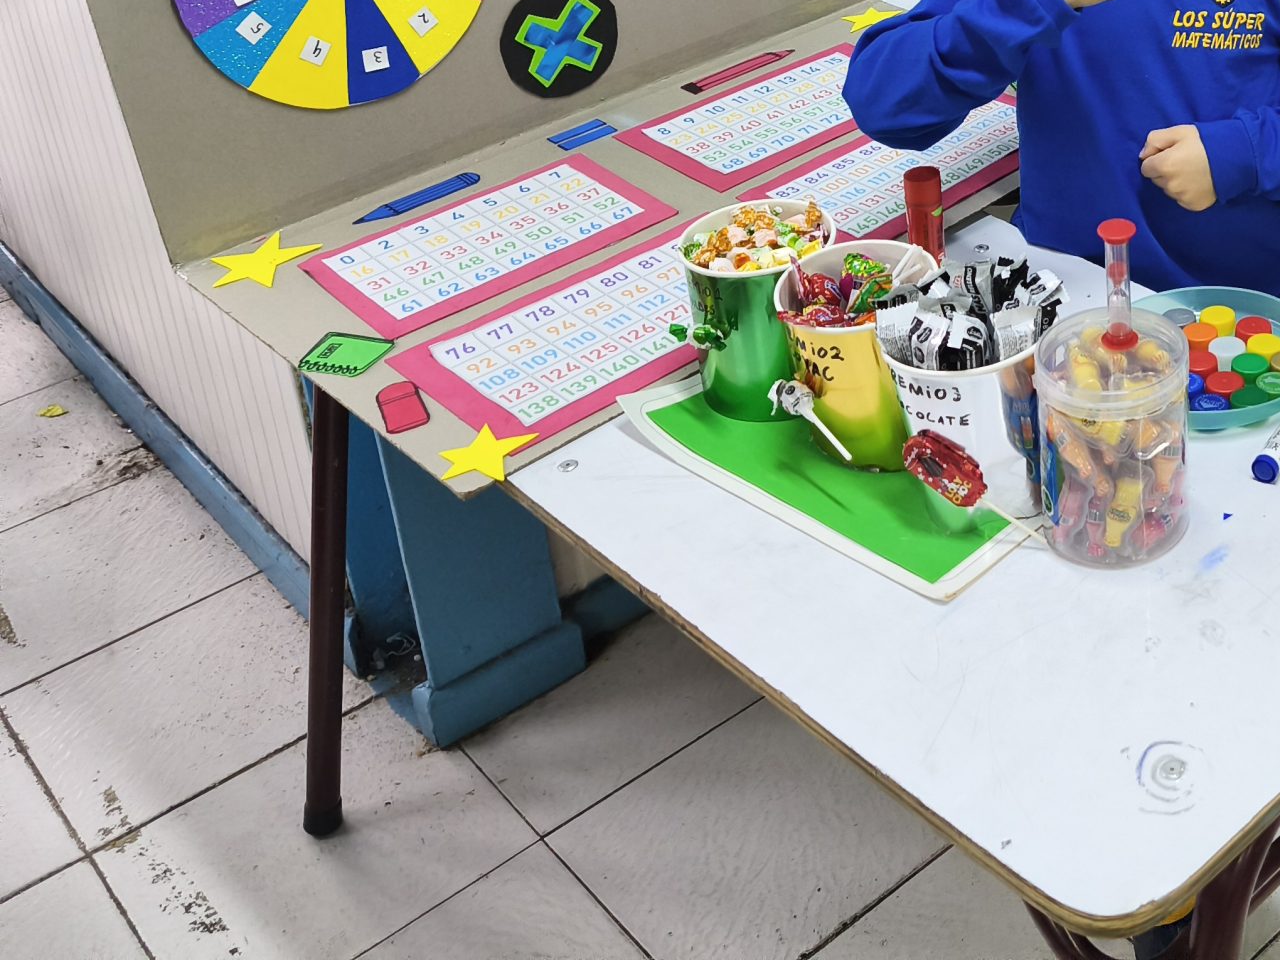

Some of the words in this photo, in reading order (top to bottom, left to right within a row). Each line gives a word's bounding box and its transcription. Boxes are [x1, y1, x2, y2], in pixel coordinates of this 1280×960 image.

[1171, 30, 1263, 51] MATEMÁTICOS
[1172, 9, 1207, 29] LOS
[1211, 7, 1265, 31] SÚPER
[686, 142, 710, 154] 38
[712, 131, 734, 142] 39
[740, 120, 762, 132] 40
[766, 110, 784, 120] 41
[789, 100, 810, 110] 42
[812, 90, 833, 100] 43
[705, 105, 726, 115] 10
[732, 96, 749, 104] 11
[754, 86, 774, 94] 12
[776, 76, 797, 85] 13
[800, 66, 820, 75] 14
[824, 57, 843, 65] 15
[702, 150, 727, 162] 53
[728, 140, 754, 150] 54
[754, 128, 778, 139] 55
[780, 117, 802, 128] 56
[804, 106, 824, 117] 57
[722, 158, 744, 170] 68
[748, 146, 769, 159] 69
[771, 135, 795, 147] 70
[798, 124, 818, 134] 71
[820, 114, 844, 124] 72
[776, 186, 800, 198] 83
[804, 172, 830, 184] 84
[832, 158, 856, 170] 85
[859, 144, 882, 156] 86
[340, 255, 355, 264] 0
[378, 240, 394, 250] 2
[414, 226, 430, 235] 3
[452, 212, 465, 221] 4
[482, 198, 498, 206] 5
[519, 185, 530, 193] 6
[548, 171, 562, 179] 7
[820, 177, 849, 193] 100
[848, 164, 876, 178] 101
[848, 216, 879, 235] 145
[876, 200, 906, 218] 146
[958, 158, 985, 174] 149
[982, 144, 1011, 160] 150
[867, 172, 892, 186] 117
[367, 276, 392, 290] 31
[404, 260, 432, 276] 32
[440, 245, 468, 260] 33
[475, 230, 504, 245] 34
[509, 215, 536, 230] 35
[544, 202, 570, 215] 36
[576, 188, 601, 201] 37
[383, 288, 410, 302] 46
[422, 271, 445, 286] 47
[459, 256, 485, 271] 48
[494, 241, 517, 256] 49
[525, 226, 553, 240] 50
[561, 212, 586, 224] 51
[593, 196, 621, 210] 52
[401, 299, 424, 313] 61
[438, 282, 465, 297] 62
[475, 267, 500, 281] 63
[510, 252, 536, 266] 64
[544, 236, 569, 251] 65
[579, 222, 602, 236] 66
[612, 206, 634, 220] 67
[445, 342, 476, 360] 76
[486, 323, 514, 340] 77
[525, 306, 556, 322] 78
[563, 288, 590, 304] 79
[600, 272, 629, 288] 80
[638, 256, 662, 270] 81
[466, 358, 498, 373] 92
[508, 338, 537, 354] 93
[546, 320, 576, 336] 94
[584, 302, 613, 317] 95
[620, 284, 648, 298] 96
[656, 266, 681, 281] 97
[478, 368, 520, 390] 108
[521, 349, 558, 370] 109
[562, 331, 597, 350] 110
[603, 313, 632, 329] 111
[638, 294, 671, 312] 112
[498, 382, 539, 404] 123
[540, 362, 582, 384] 124
[580, 342, 618, 363] 125
[618, 324, 656, 344] 126
[656, 304, 689, 324] 127
[518, 395, 560, 419] 138
[561, 374, 598, 396] 139
[600, 354, 640, 376] 140
[640, 336, 676, 356] 141
